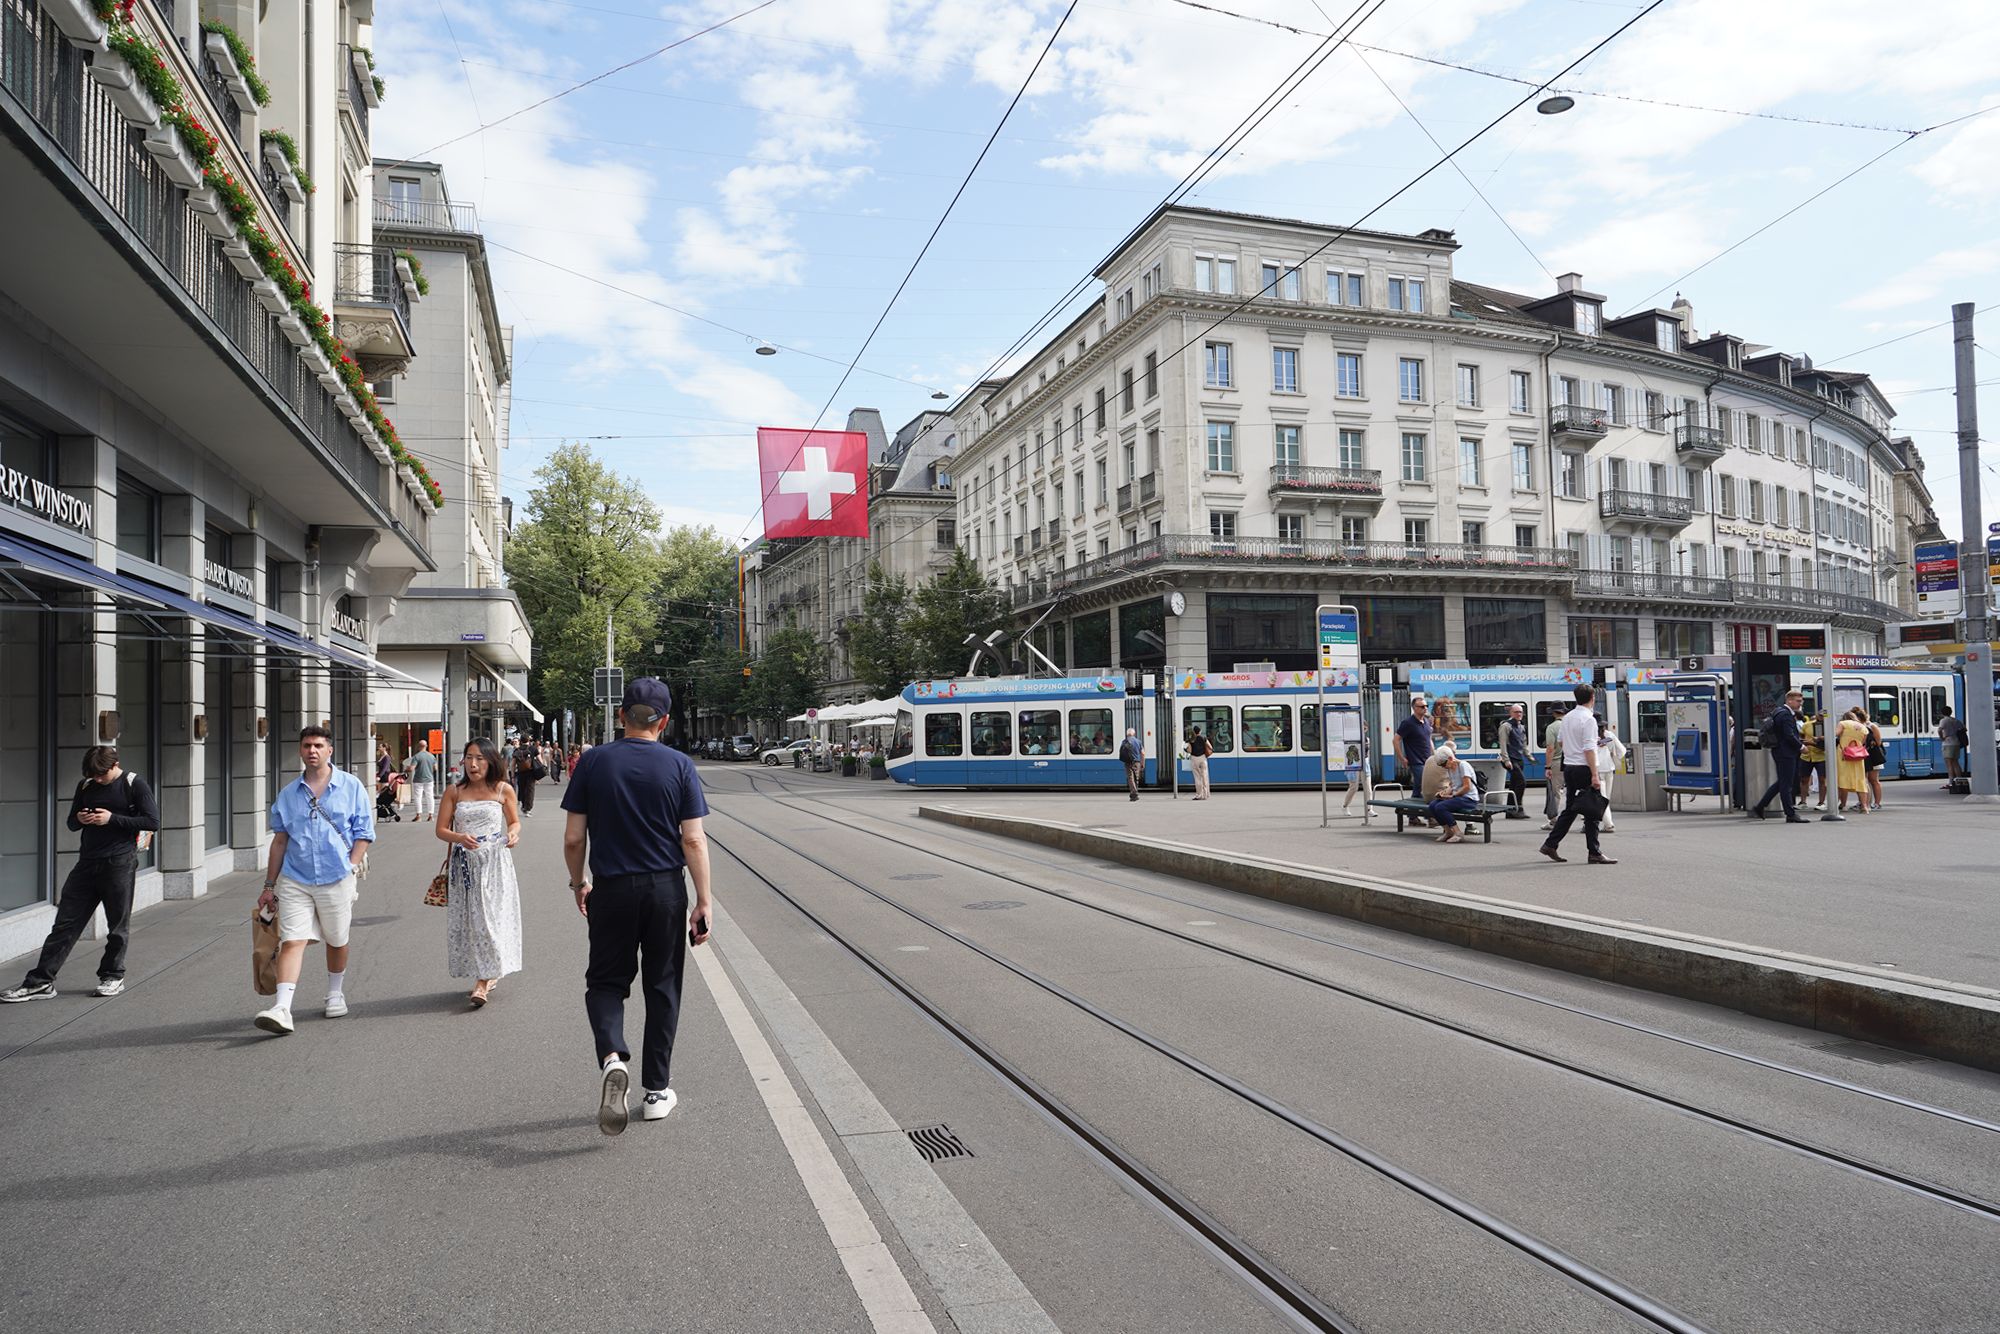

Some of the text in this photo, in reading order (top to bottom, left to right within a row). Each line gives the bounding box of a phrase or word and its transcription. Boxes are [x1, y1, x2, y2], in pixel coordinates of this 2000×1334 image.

[31, 478, 92, 530] WINSTON
[205, 558, 255, 600] HARRY WINSTON
[331, 605, 368, 642] BLANCPAIN
[1689, 659, 1698, 670] 5
[1805, 656, 1846, 666] EXCENCE
[1847, 658, 1855, 666] IN
[1855, 658, 1880, 666] HIGHER
